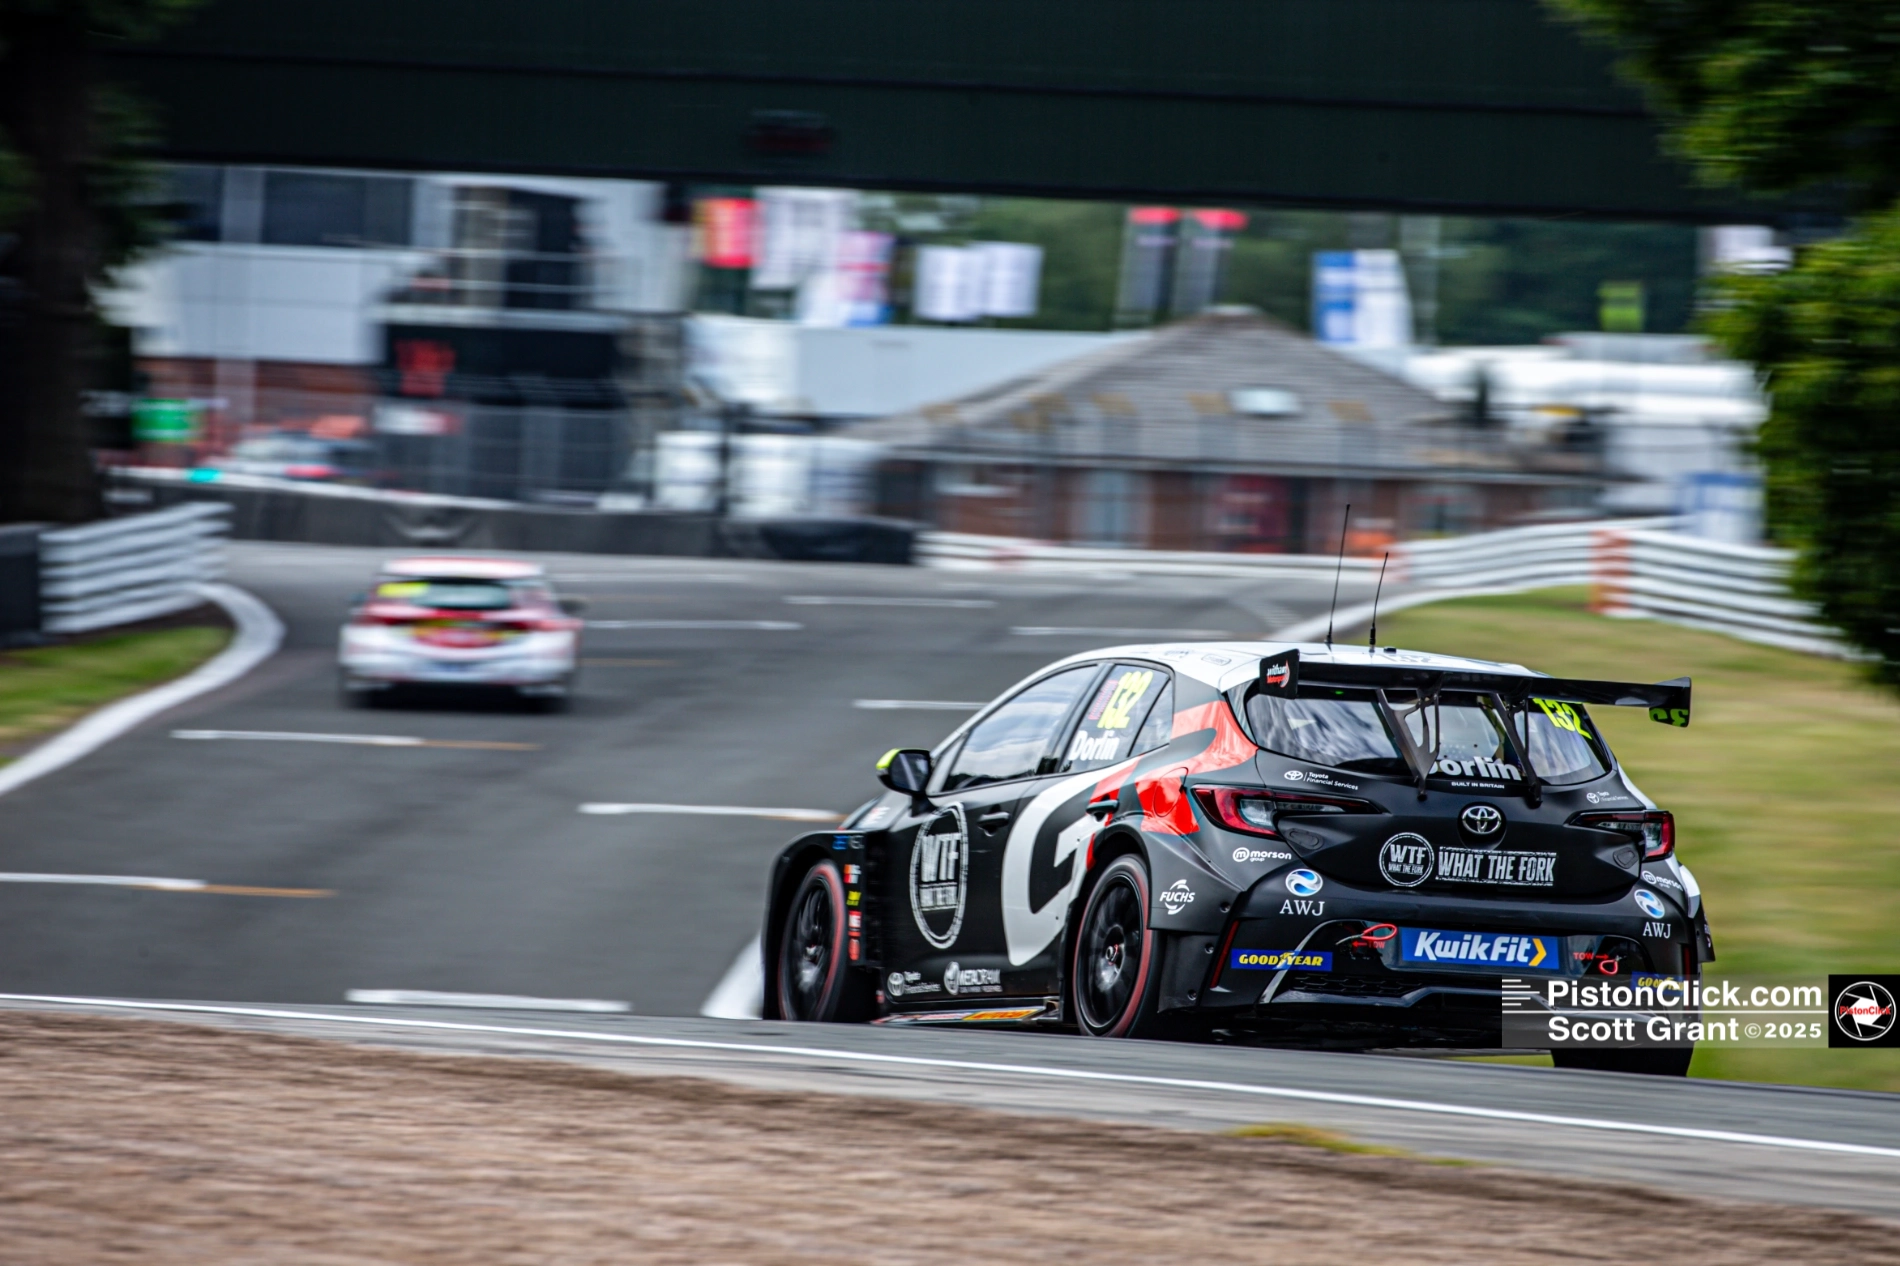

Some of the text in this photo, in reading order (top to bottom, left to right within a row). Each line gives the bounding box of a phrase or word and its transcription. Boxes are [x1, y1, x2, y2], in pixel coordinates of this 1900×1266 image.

[1097, 671, 1153, 729] 132
[1533, 697, 1592, 740] 132
[1068, 730, 1120, 761] Dorlin
[1308, 771, 1329, 780] Toyota
[1428, 756, 1522, 781] orlin
[1307, 777, 1359, 790] Financial Services
[1250, 850, 1292, 861] morson
[1390, 844, 1427, 865] WTF
[1438, 851, 1556, 882] WHAT THE FORK
[1159, 891, 1196, 903] FUCHS
[1279, 899, 1326, 917] AWJ
[1642, 921, 1671, 939] AWJ
[1573, 951, 1594, 960] TOW
